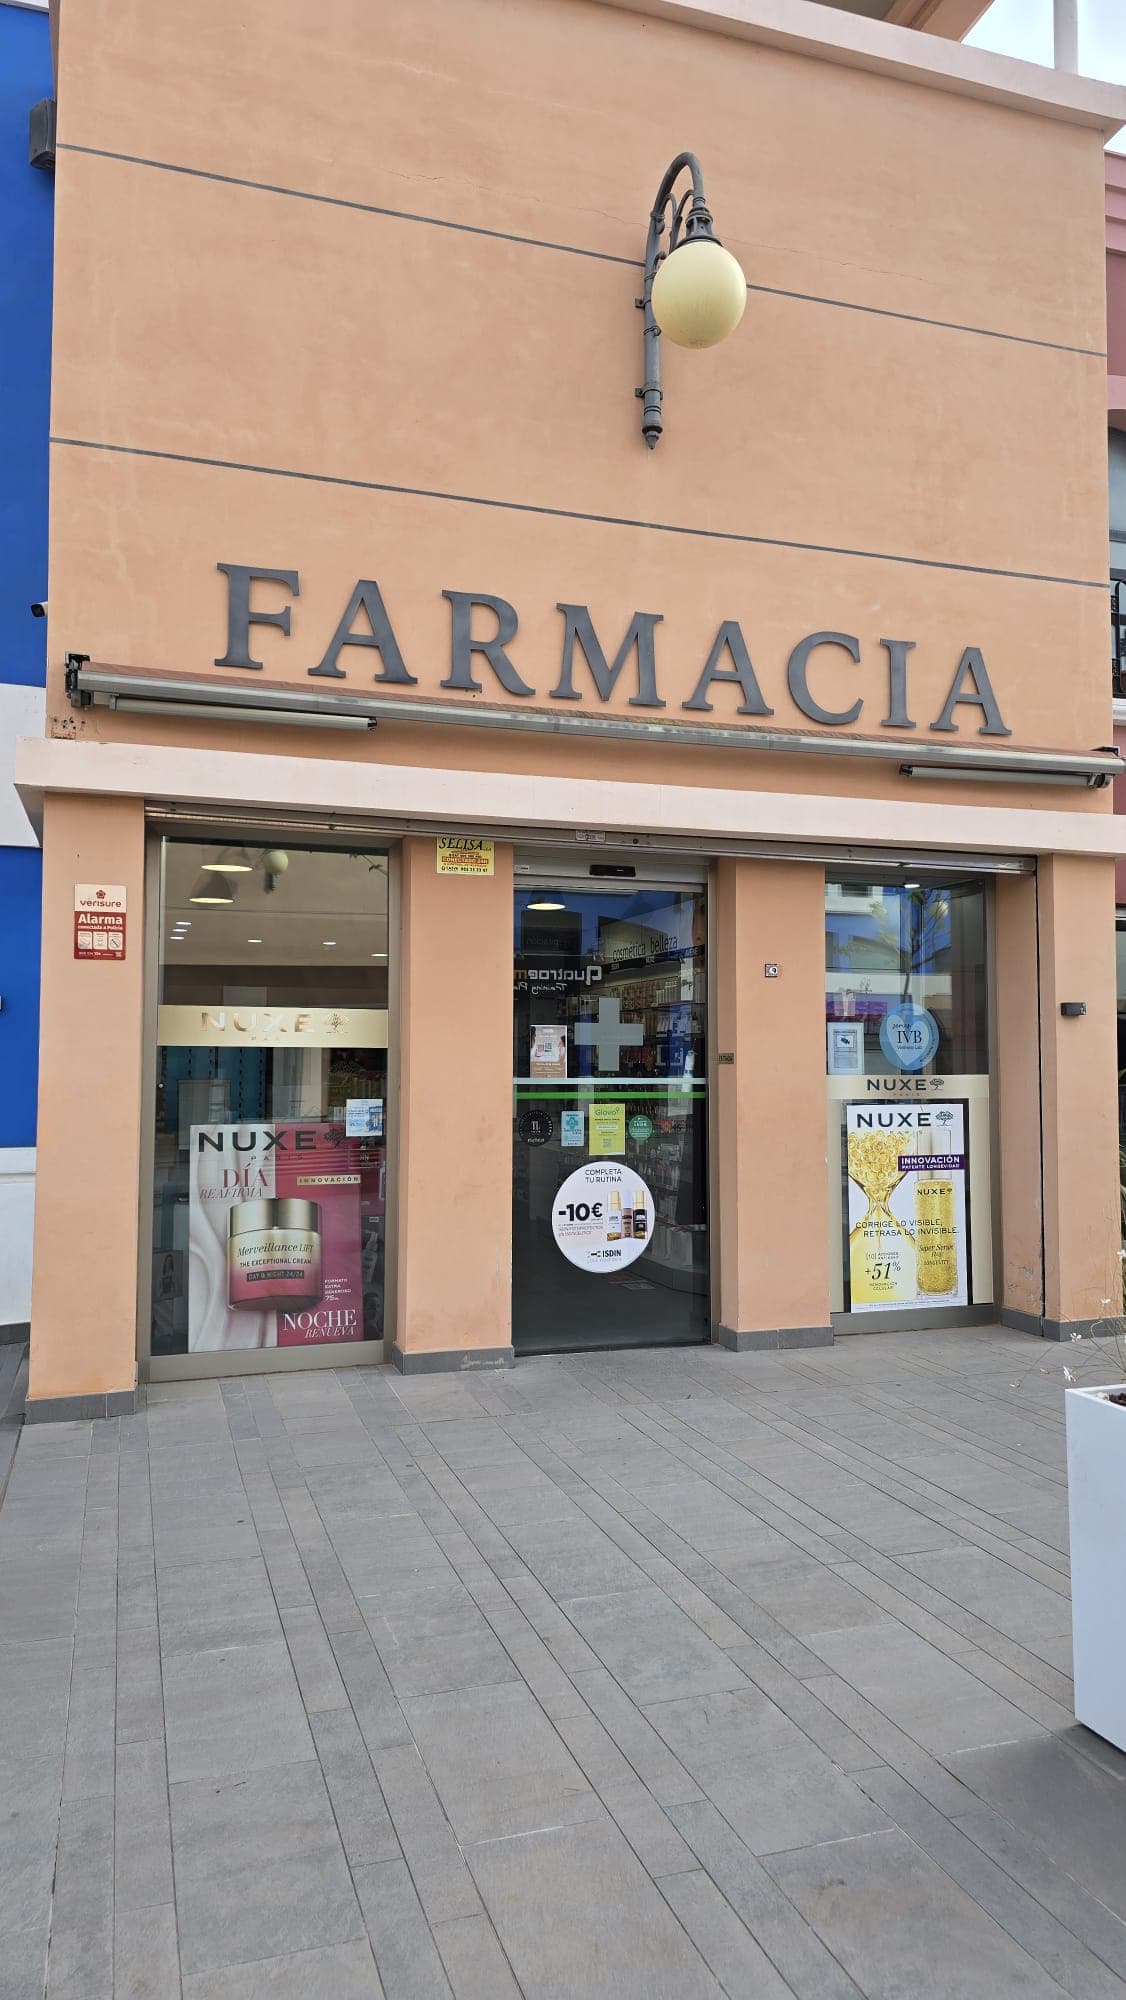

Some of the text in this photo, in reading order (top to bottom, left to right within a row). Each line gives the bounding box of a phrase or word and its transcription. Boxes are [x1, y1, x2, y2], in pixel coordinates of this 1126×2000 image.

[214, 562, 1012, 736] FARMACIA
[439, 837, 483, 850] SELISA
[78, 913, 123, 925] Alarma
[650, 935, 678, 953] belleza
[201, 1012, 315, 1033] NUXE
[897, 1030, 922, 1044] IVB
[867, 1079, 927, 1091] NUXE
[856, 1112, 932, 1128] NUXE
[198, 1130, 317, 1153] NUXE
[901, 1155, 960, 1164] INNOVACIÓN
[223, 1162, 269, 1188] DÍA
[585, 1168, 622, 1176] COMPLETA
[299, 1175, 360, 1184] INNOVACIÓN
[585, 1176, 595, 1184] TU
[199, 1187, 263, 1200] REAFIRMA
[558, 1202, 603, 1222] -10€
[855, 1220, 893, 1229] CORRIGE
[909, 1218, 943, 1227] VISIBLE,
[863, 1226, 960, 1238] RETRASA LO INVISIBLE.
[237, 1242, 298, 1257] Merveillance
[602, 1249, 622, 1258] ISDIN
[251, 1258, 291, 1267] EXCEPTIONAL
[864, 1261, 901, 1280] +51%
[282, 1309, 357, 1332] NOCHE
[304, 1326, 354, 1338] RENUEVA
